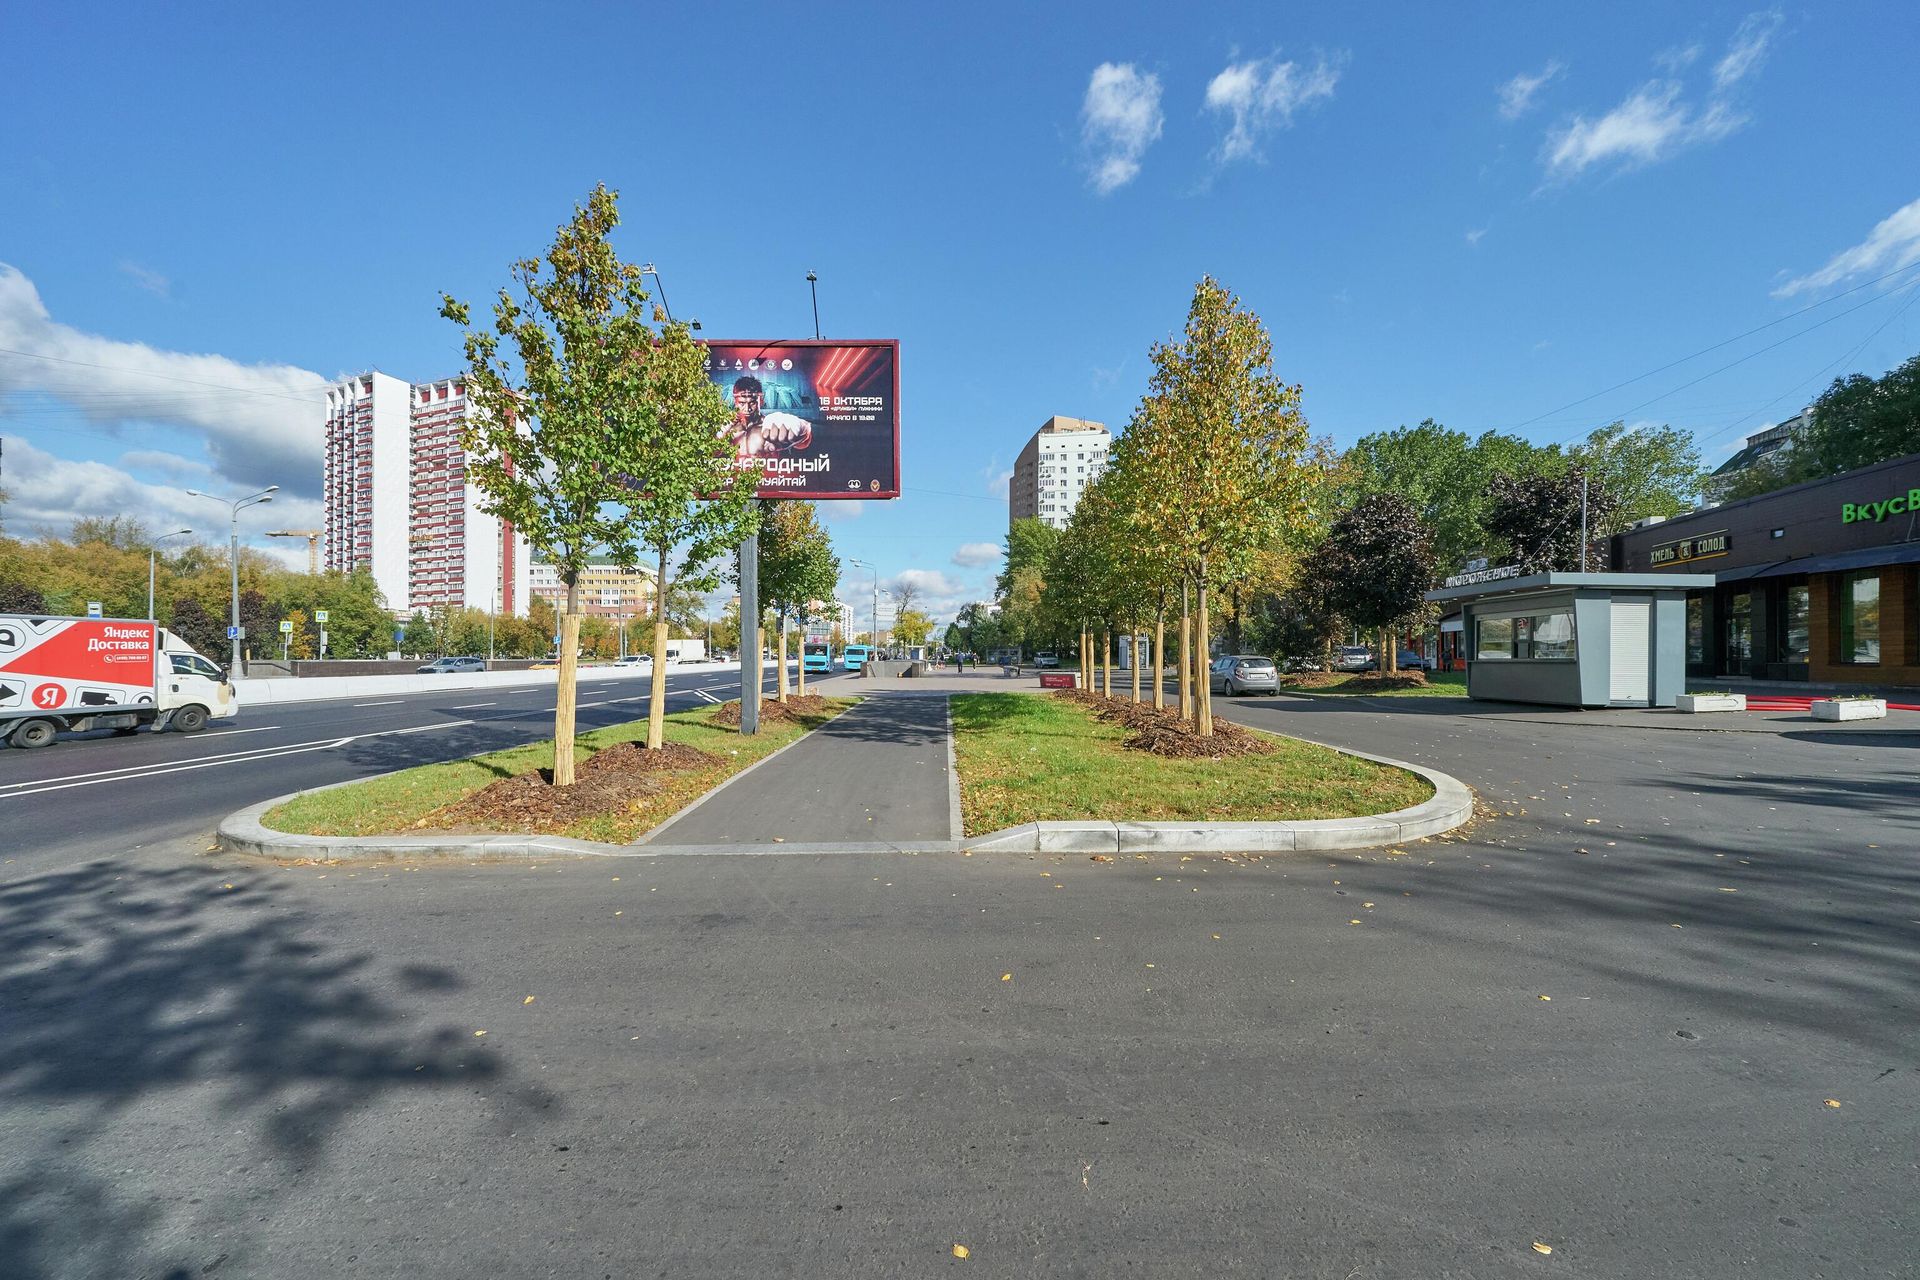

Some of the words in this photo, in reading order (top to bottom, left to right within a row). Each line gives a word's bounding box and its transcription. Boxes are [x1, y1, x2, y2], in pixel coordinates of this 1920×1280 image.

[834, 397, 882, 405] ОКТЯБРЯ
[1650, 547, 1675, 564] ХМЕЛЬ
[1697, 535, 1725, 554] СОЛОД
[1445, 563, 1520, 588] МОРОЖЕНОЕ
[104, 627, 149, 638] Яндекс
[88, 639, 149, 651] Доставка
[40, 687, 59, 706] Я
